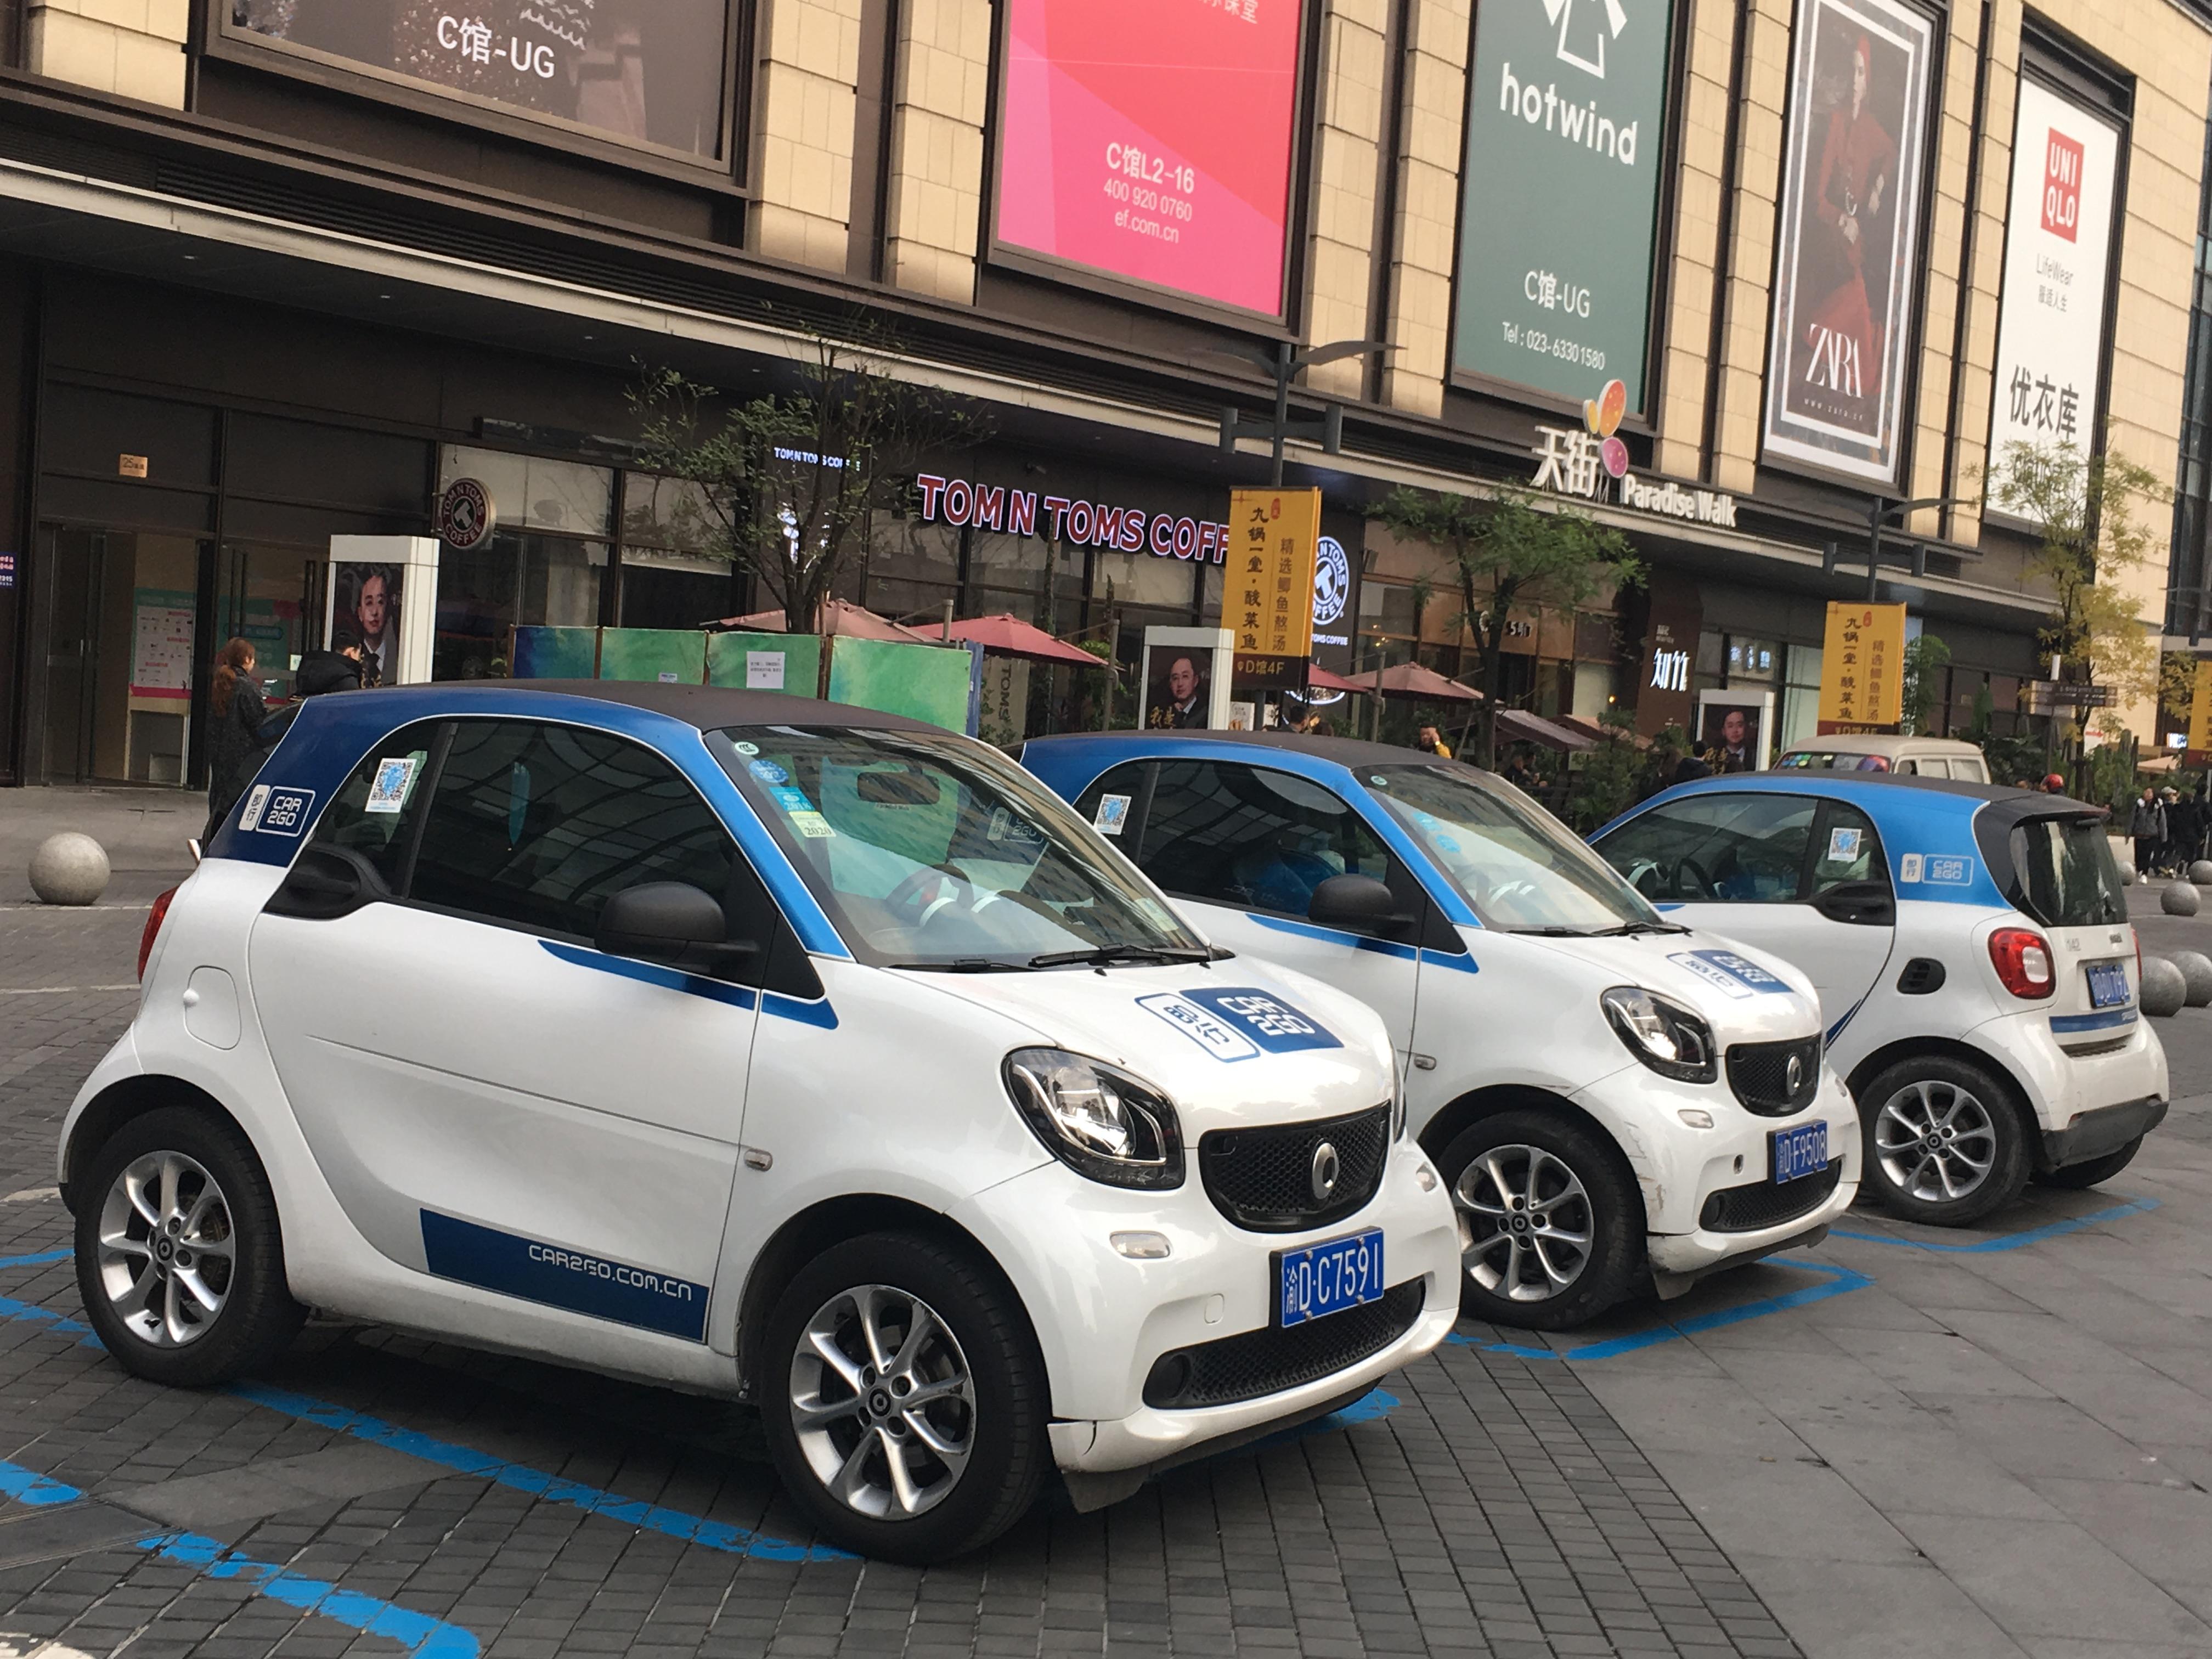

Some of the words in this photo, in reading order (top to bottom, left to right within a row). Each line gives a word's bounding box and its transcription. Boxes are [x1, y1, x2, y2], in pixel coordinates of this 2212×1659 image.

[437, 15, 555, 78] C馆-UG
[1500, 62, 1638, 165] hotwind
[1106, 143, 1194, 194] C馆L2-16
[2050, 142, 2078, 187] UNI
[1103, 178, 1129, 202] 400
[1132, 186, 1157, 211] 920
[1160, 195, 1192, 222] 0760
[2046, 185, 2075, 228] QLO
[1115, 210, 1179, 243] ef.com.cn
[1525, 270, 1590, 318] C馆-UG
[1805, 323, 1864, 398] ZARA
[2010, 364, 2079, 439] 优衣库
[774, 447, 794, 460] TOM
[1529, 425, 1600, 497] 天街
[443, 489, 458, 517] TOM
[456, 484, 464, 494] N
[465, 484, 484, 516] TOMS
[917, 474, 1003, 530] TOM
[1008, 489, 1037, 535] N
[1044, 496, 1146, 552] TOMS
[1621, 474, 1695, 519] Paradise
[1694, 490, 1737, 527] Walk
[445, 522, 482, 544] COFFEE
[1328, 544, 1346, 586] TOMS
[1245, 661, 1285, 675] D馆4F
[267, 810, 296, 826] 2GO
[273, 796, 302, 812] CAR
[804, 827, 832, 835] 2020
[1932, 870, 1962, 880] 2GO
[1933, 860, 1963, 871] CAR
[529, 1244, 692, 1301] CAR2GO.COM.CN
